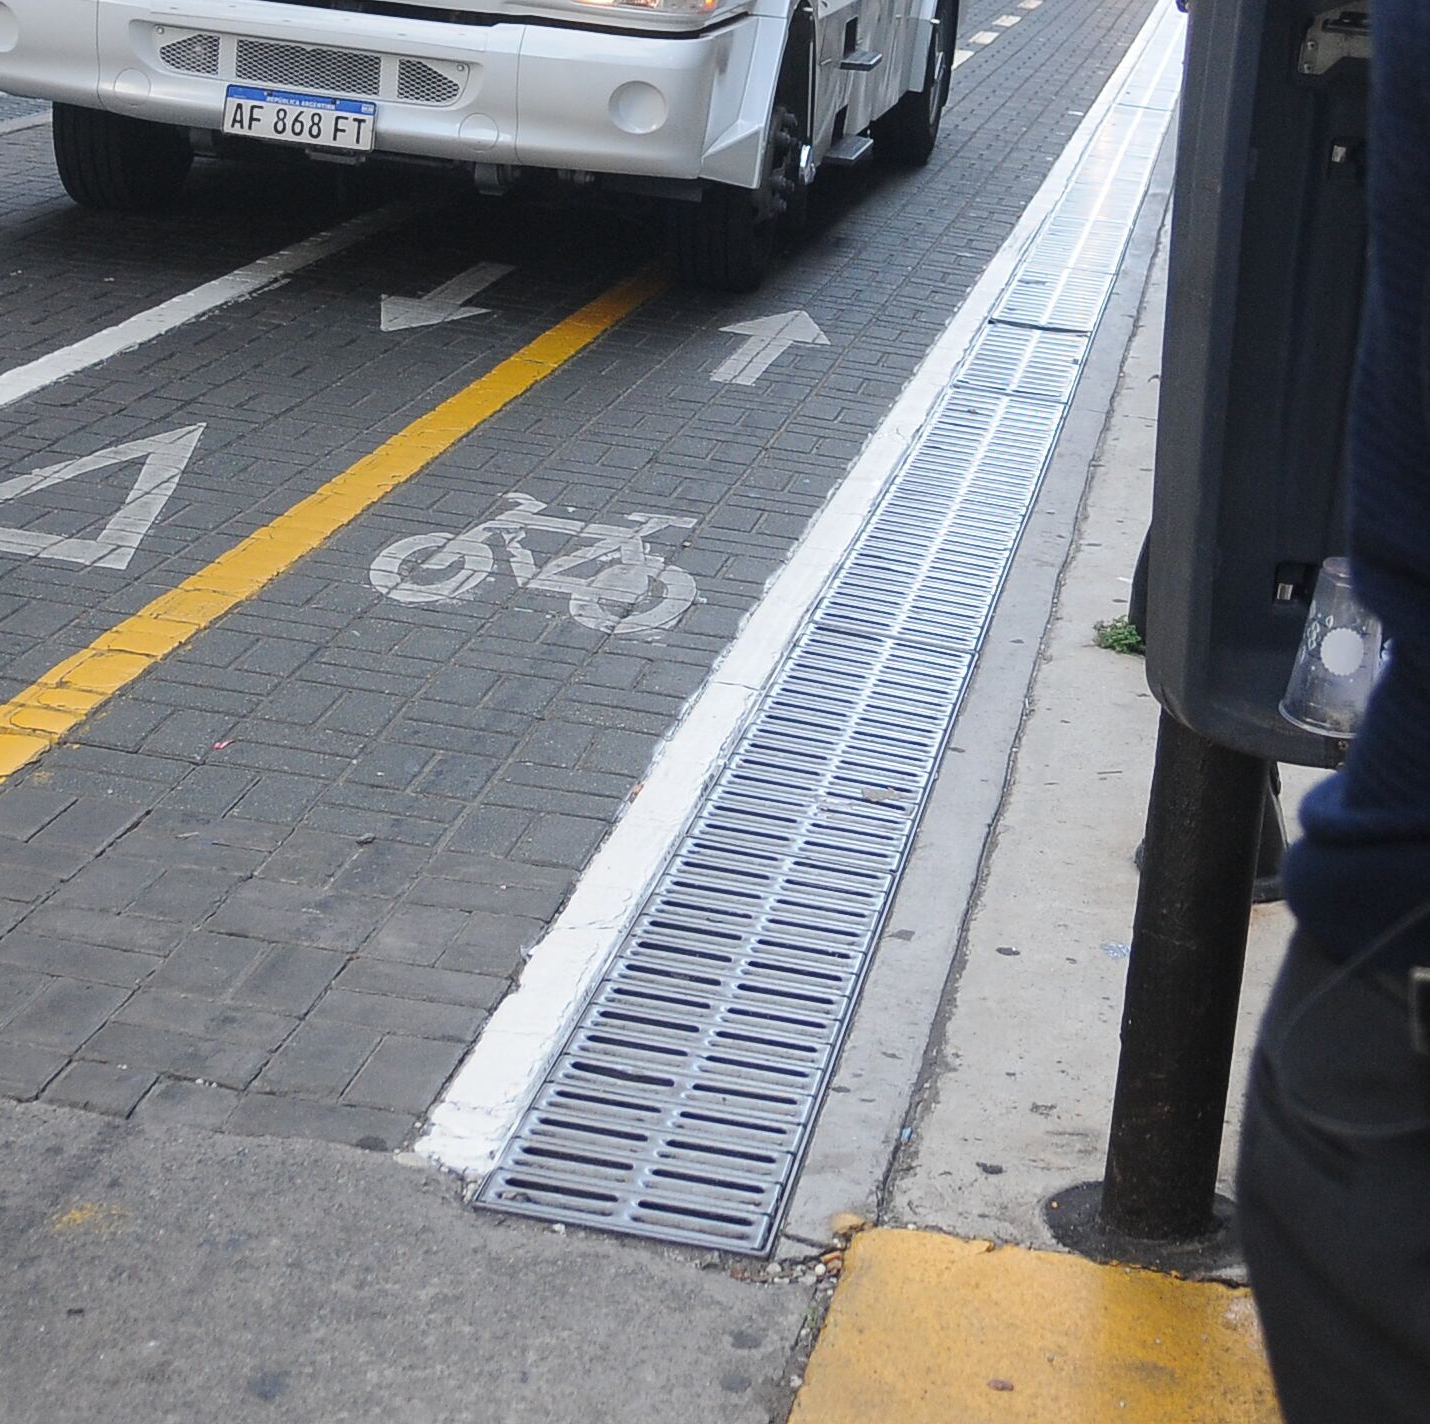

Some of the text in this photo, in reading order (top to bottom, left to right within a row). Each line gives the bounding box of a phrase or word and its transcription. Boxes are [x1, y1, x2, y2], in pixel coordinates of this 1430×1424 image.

[231, 102, 366, 144] AF 868 FT
